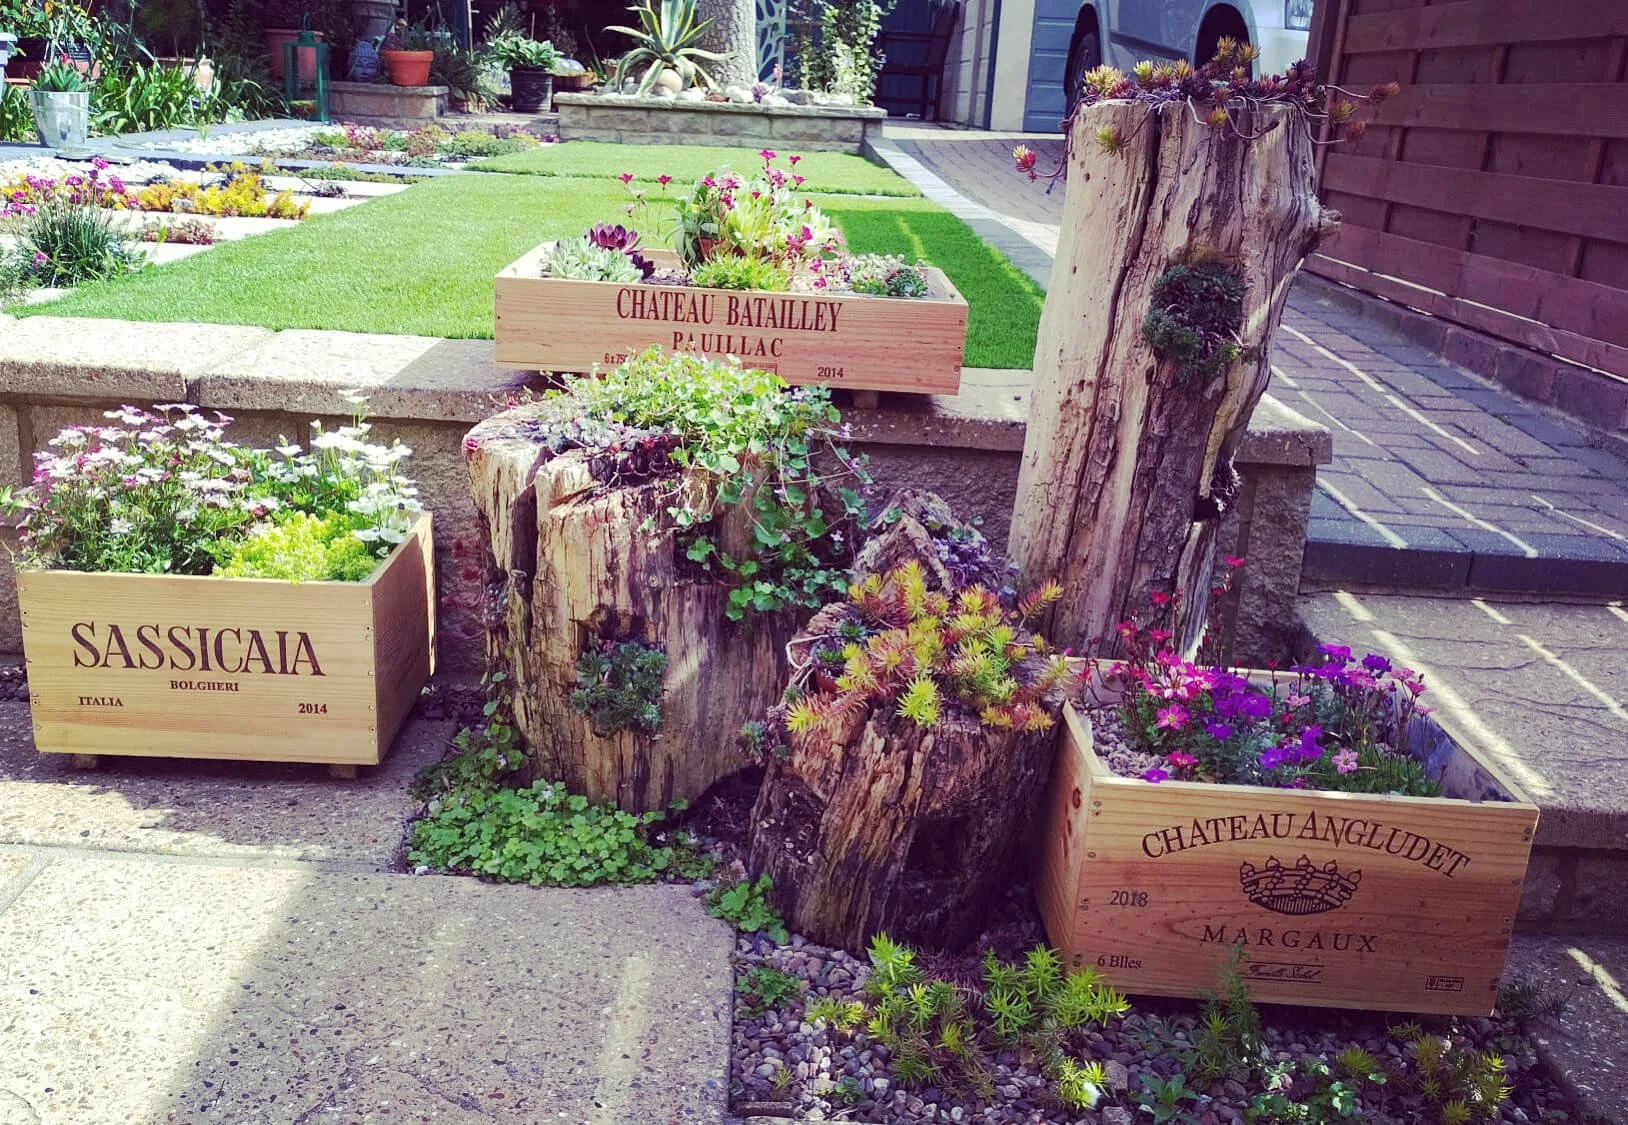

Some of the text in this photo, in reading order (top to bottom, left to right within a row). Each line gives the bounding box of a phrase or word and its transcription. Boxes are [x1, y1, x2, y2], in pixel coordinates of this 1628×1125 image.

[617, 288, 843, 332] CHATEAU BATAILLEY
[672, 331, 784, 357] PAUILLAC
[817, 367, 845, 379] 2014
[71, 620, 326, 676] SASSICAIA
[170, 680, 240, 692] BOLGHERI
[79, 696, 124, 708] ITALIA
[299, 703, 329, 715] 2014
[1142, 810, 1472, 878] CHATEAU ANGLUDET
[1110, 890, 1149, 908] 2018
[1200, 925, 1378, 953] MARGAUX
[1097, 955, 1106, 967] 6
